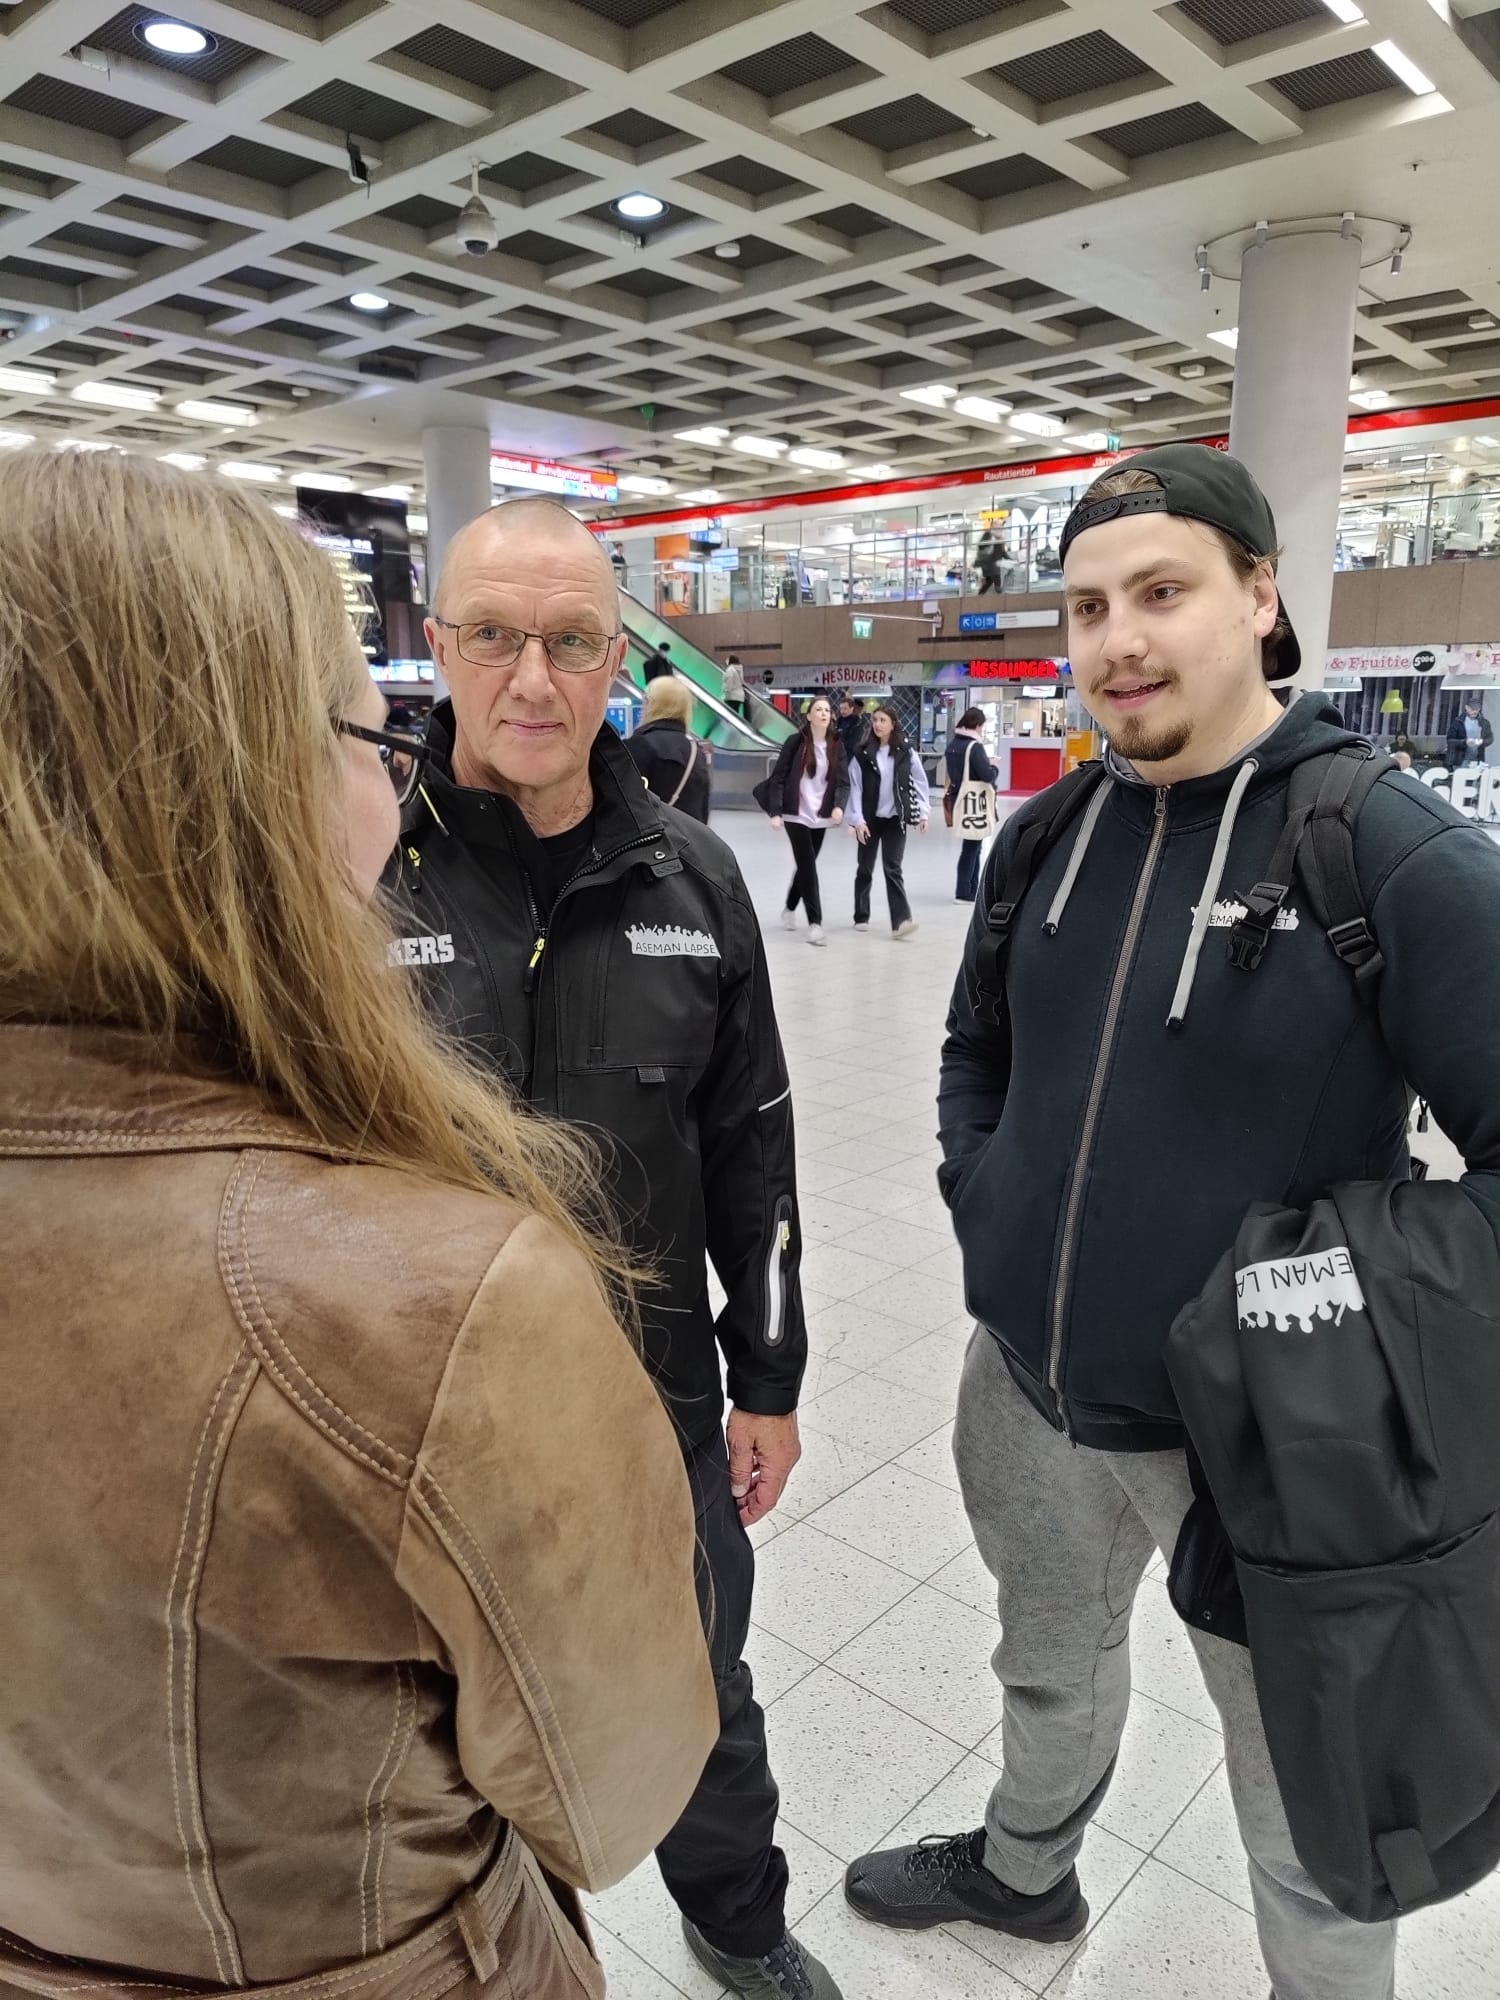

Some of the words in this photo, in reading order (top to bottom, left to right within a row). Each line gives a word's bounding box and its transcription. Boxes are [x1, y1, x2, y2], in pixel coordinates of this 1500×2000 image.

[969, 659, 1059, 679] HESBURGER
[1349, 655, 1409, 670] Fruitie
[822, 667, 886, 685] HESBURGER
[635, 942, 681, 953] ASEMAN
[1270, 1253, 1353, 1290] EMAN
